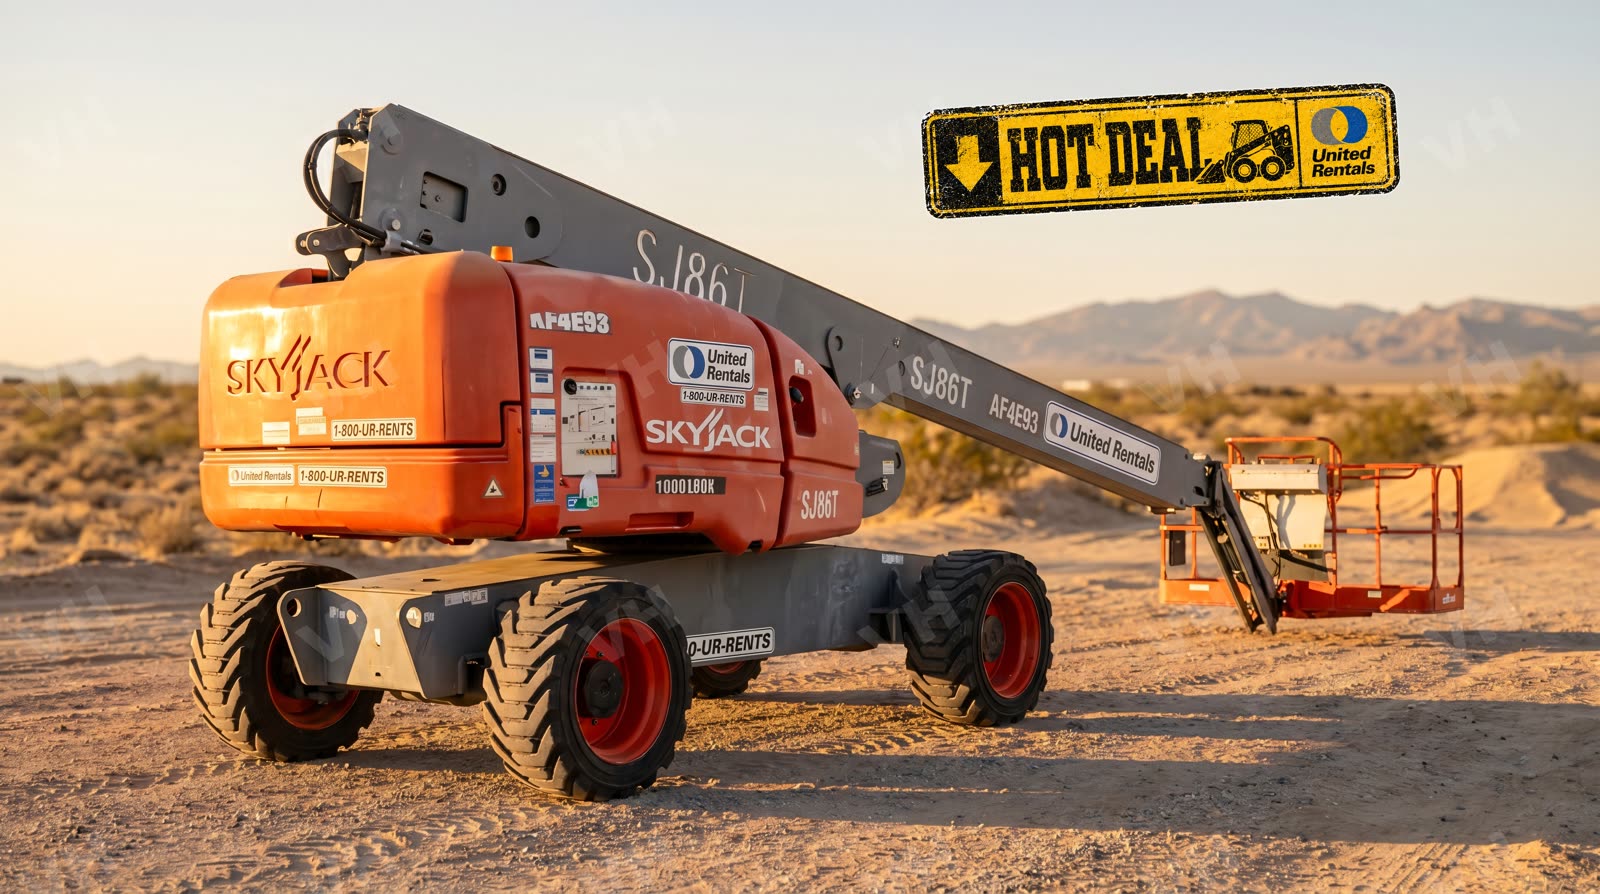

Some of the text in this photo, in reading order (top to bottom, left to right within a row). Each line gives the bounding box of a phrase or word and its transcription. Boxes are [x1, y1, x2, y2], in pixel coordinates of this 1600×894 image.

[633, 229, 757, 312] SJ86T
[227, 334, 391, 401] SKYJACK
[707, 349, 748, 367] United
[706, 366, 751, 384] Rentals
[910, 356, 973, 409] SJ86T
[683, 391, 745, 405] 1-800-UR-RENTS
[989, 393, 1039, 434] AF4E93
[333, 422, 414, 437] 1-800-UR-RENTS
[646, 408, 772, 452] SKYJACK
[1070, 421, 1156, 474] United Rentals
[240, 471, 292, 482] United Rentals
[300, 470, 384, 483] 1-800-UR-RENTS
[801, 490, 839, 520] SJ86T
[688, 633, 771, 657] 0-UR-RENTS
